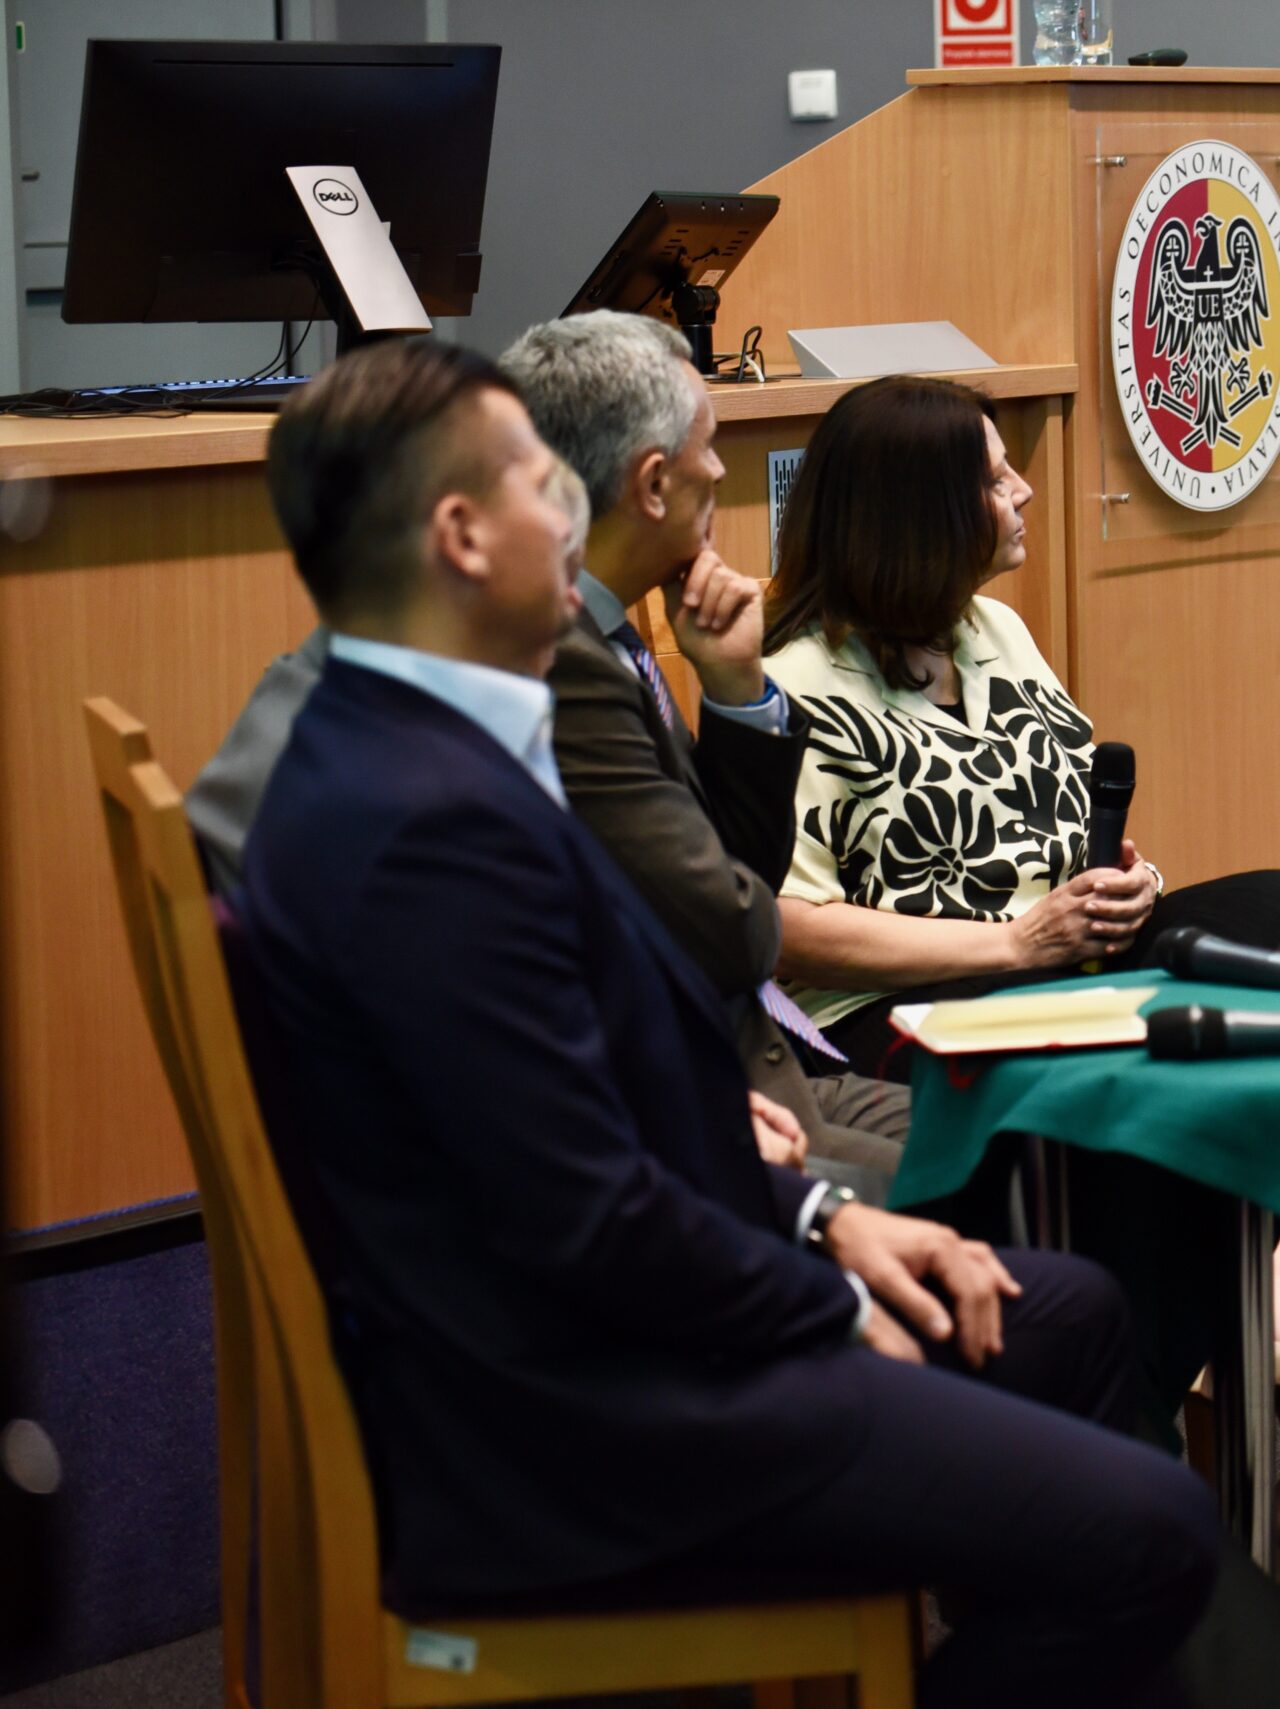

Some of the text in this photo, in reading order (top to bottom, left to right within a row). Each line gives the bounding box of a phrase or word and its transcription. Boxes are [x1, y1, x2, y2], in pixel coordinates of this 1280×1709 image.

[319, 192, 353, 201] DELL
[1128, 152, 1262, 260] OECONOMICA
[1199, 294, 1221, 317] UE
[1116, 287, 1201, 499] UNIVERSITAS
